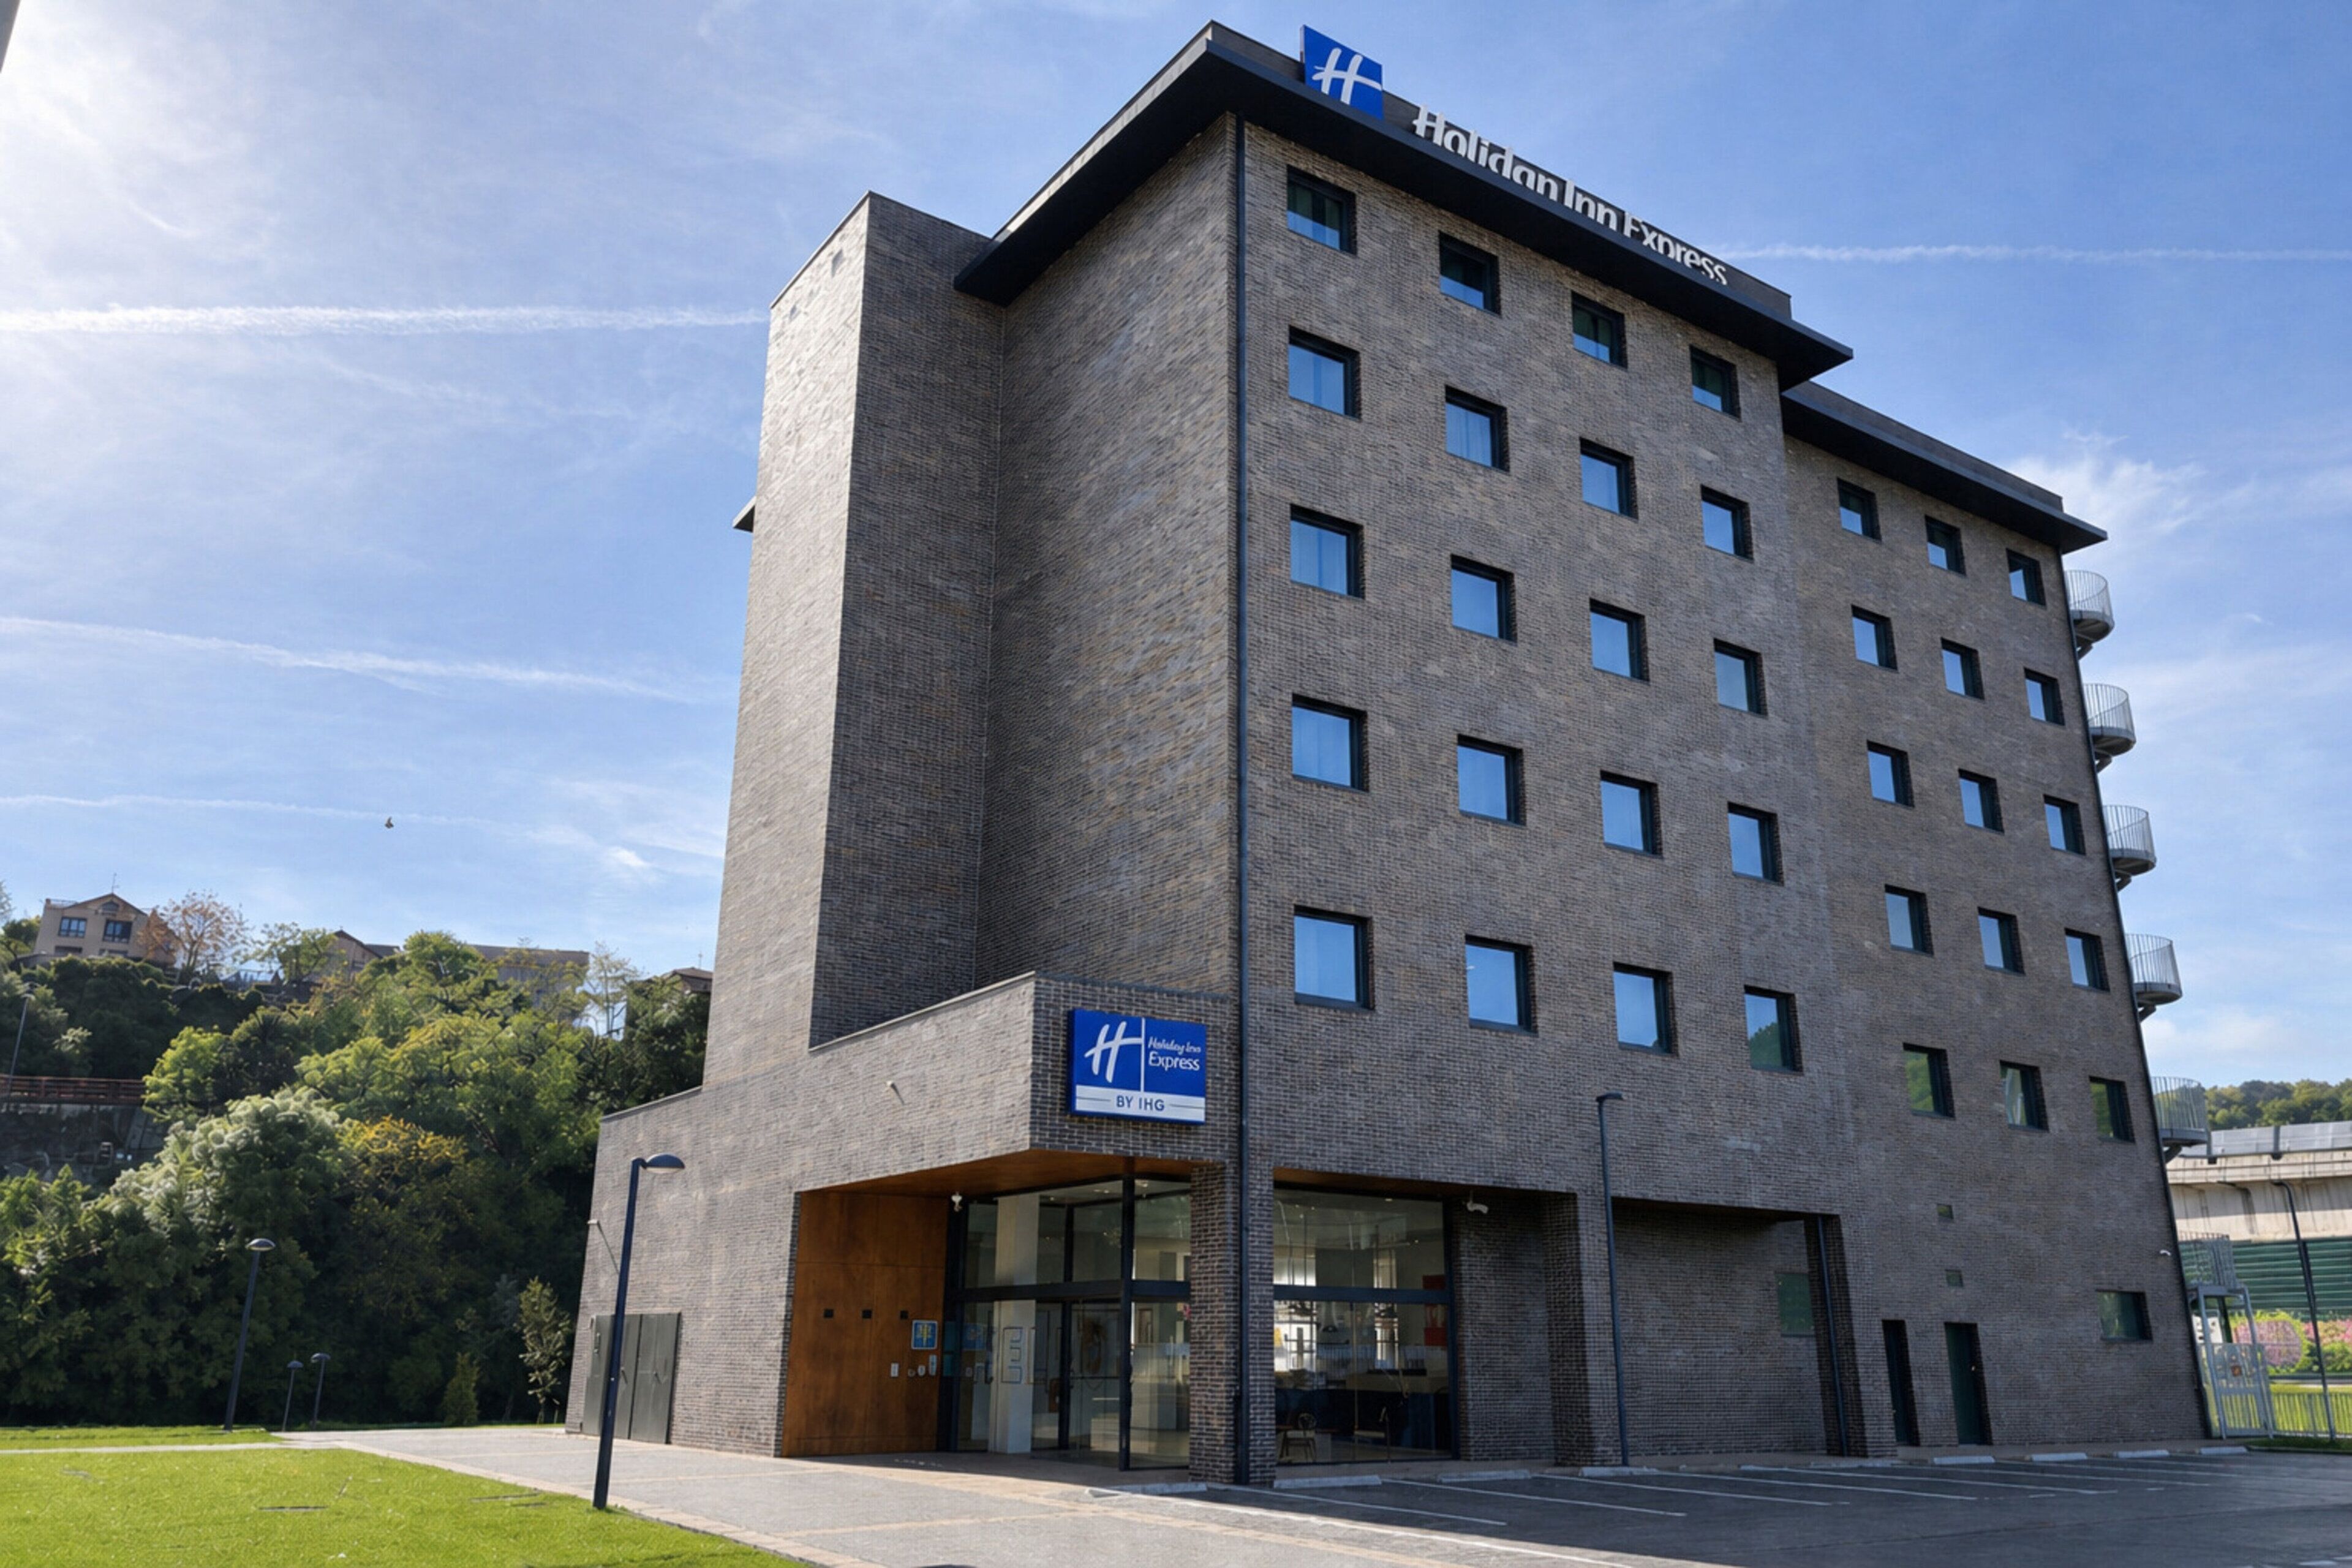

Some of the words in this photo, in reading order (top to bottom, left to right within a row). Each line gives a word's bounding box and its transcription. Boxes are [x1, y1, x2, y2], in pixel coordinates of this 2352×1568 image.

[1564, 178, 1618, 232] Inn
[1148, 1036, 1185, 1055] Holiday
[1148, 1050, 1200, 1071] Express
[1116, 1095, 1134, 1109] BY
[1139, 1097, 1165, 1112] IHG
